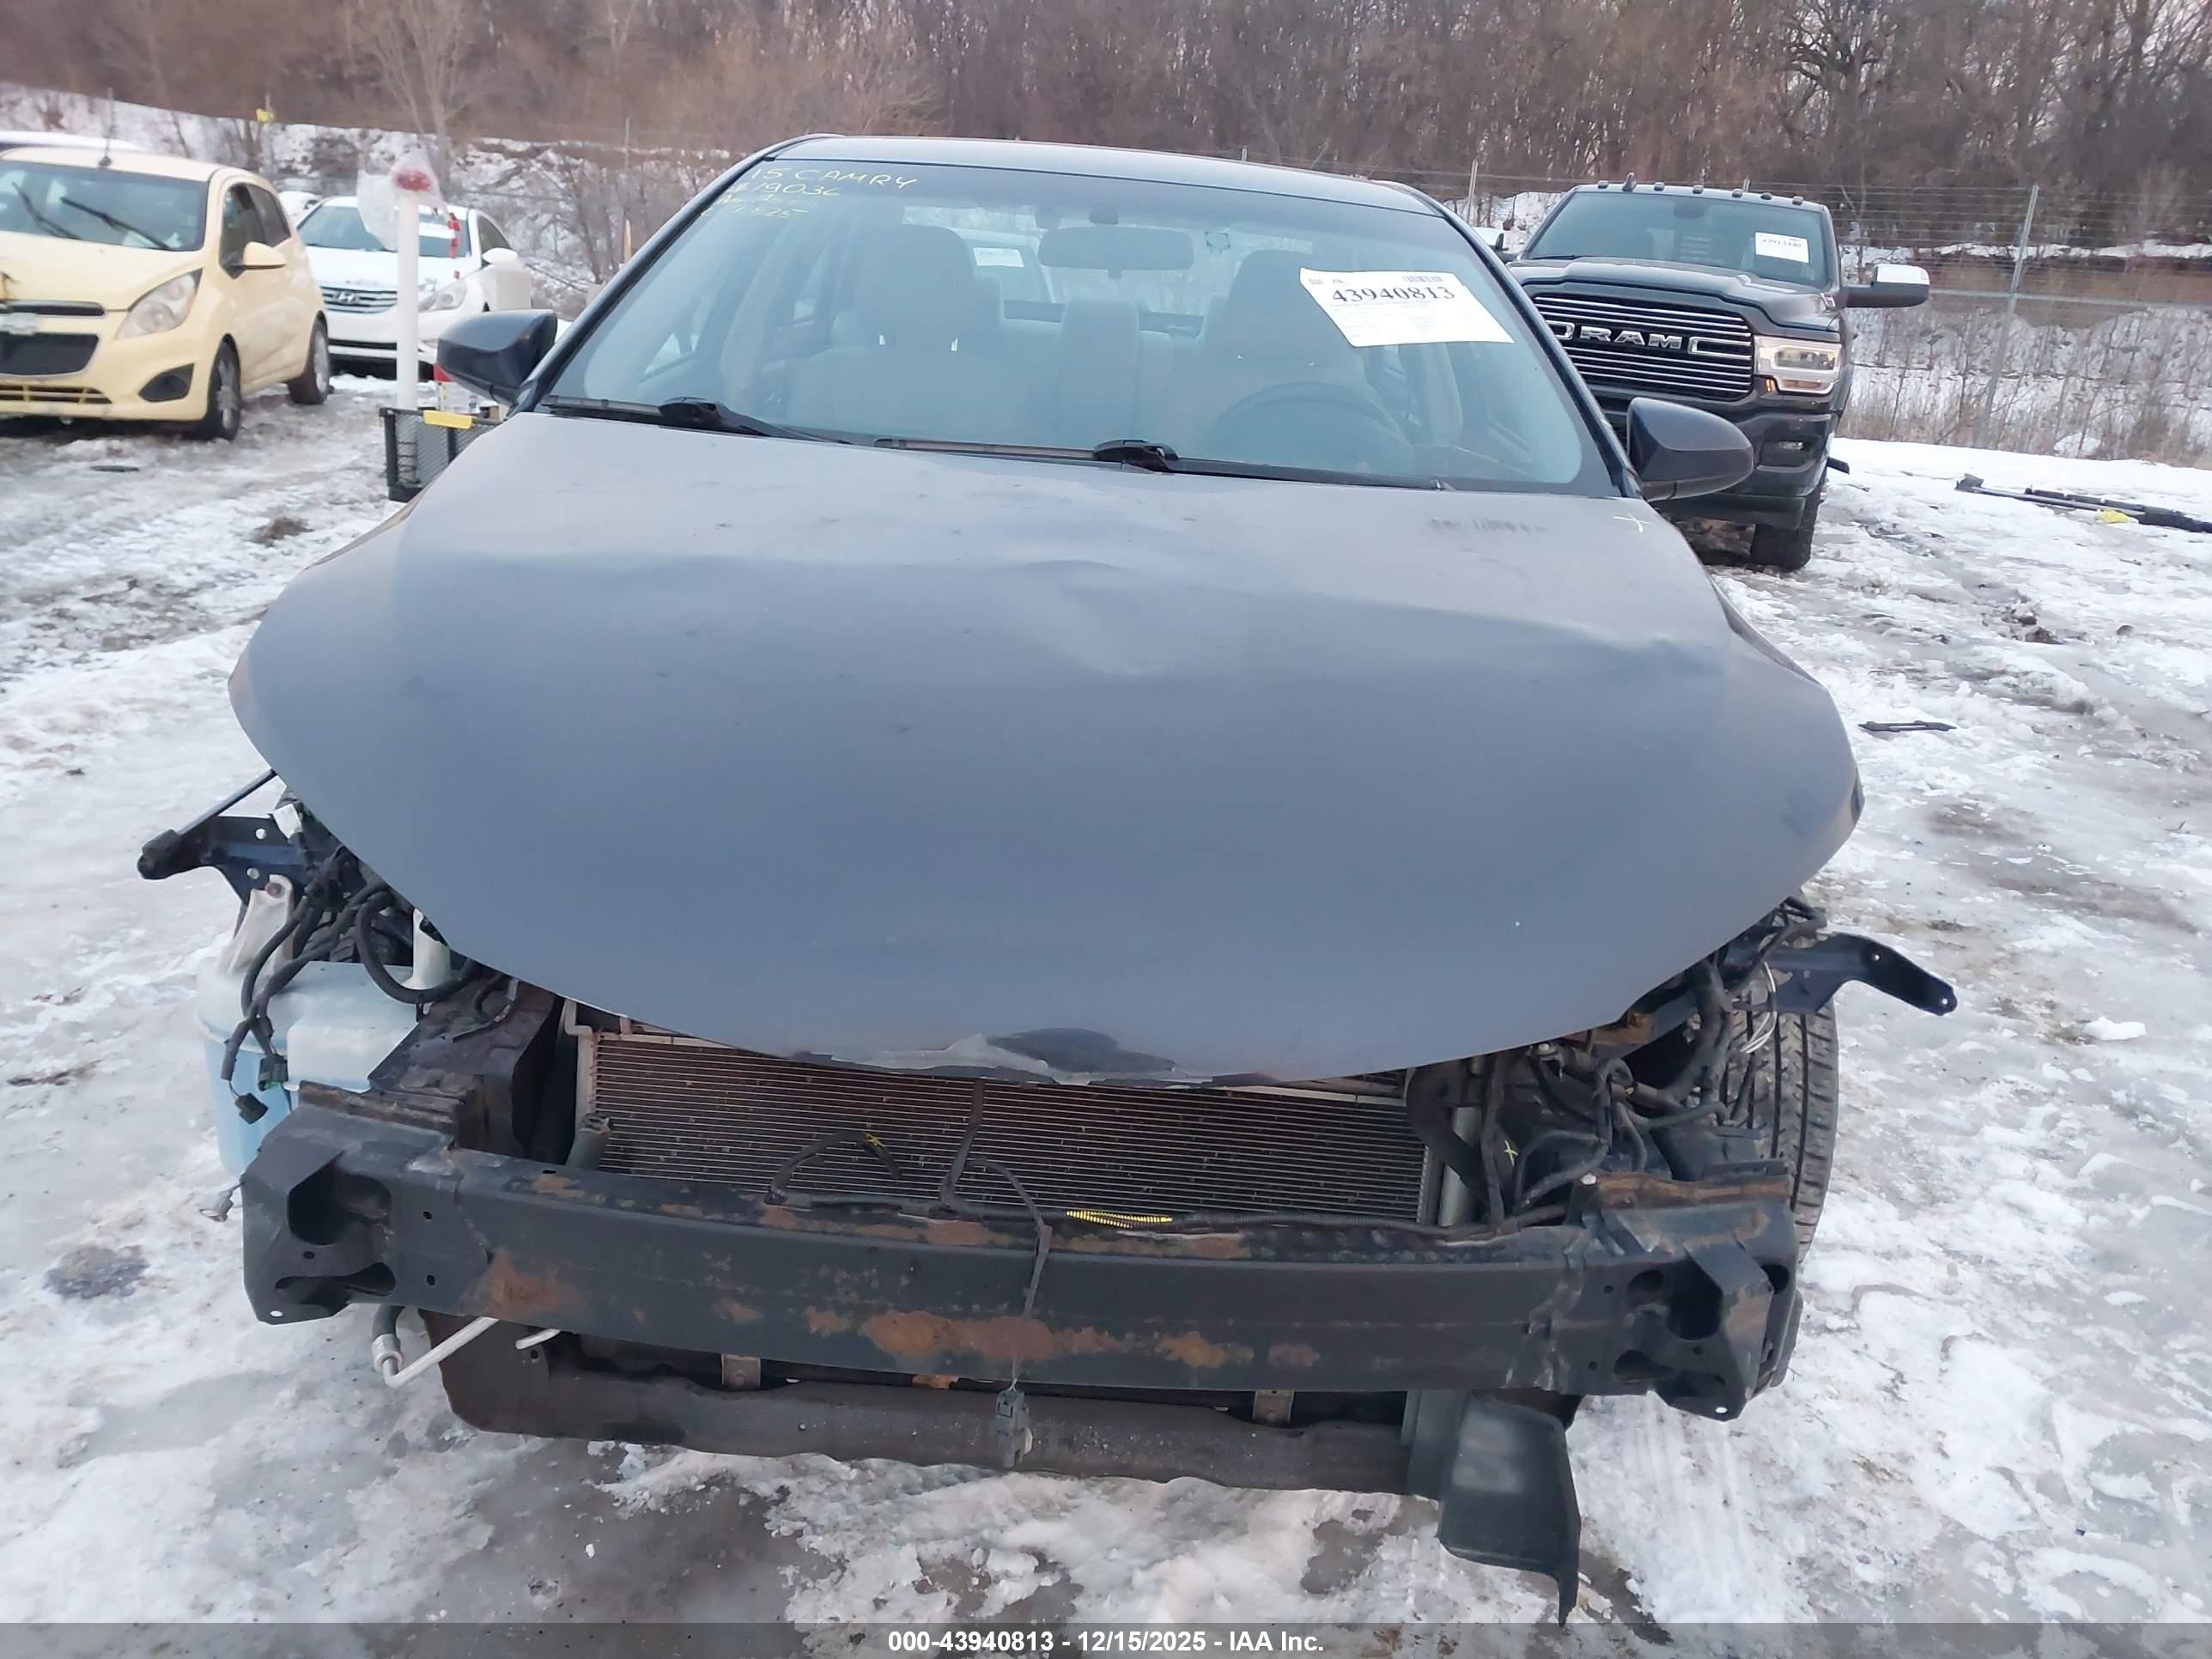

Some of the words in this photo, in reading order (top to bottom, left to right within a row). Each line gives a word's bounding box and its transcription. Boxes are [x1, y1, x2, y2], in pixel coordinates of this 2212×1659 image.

[795, 169, 917, 188] CAMRY
[1333, 286, 1455, 302] 43940813
[1580, 325, 1683, 349] RAM
